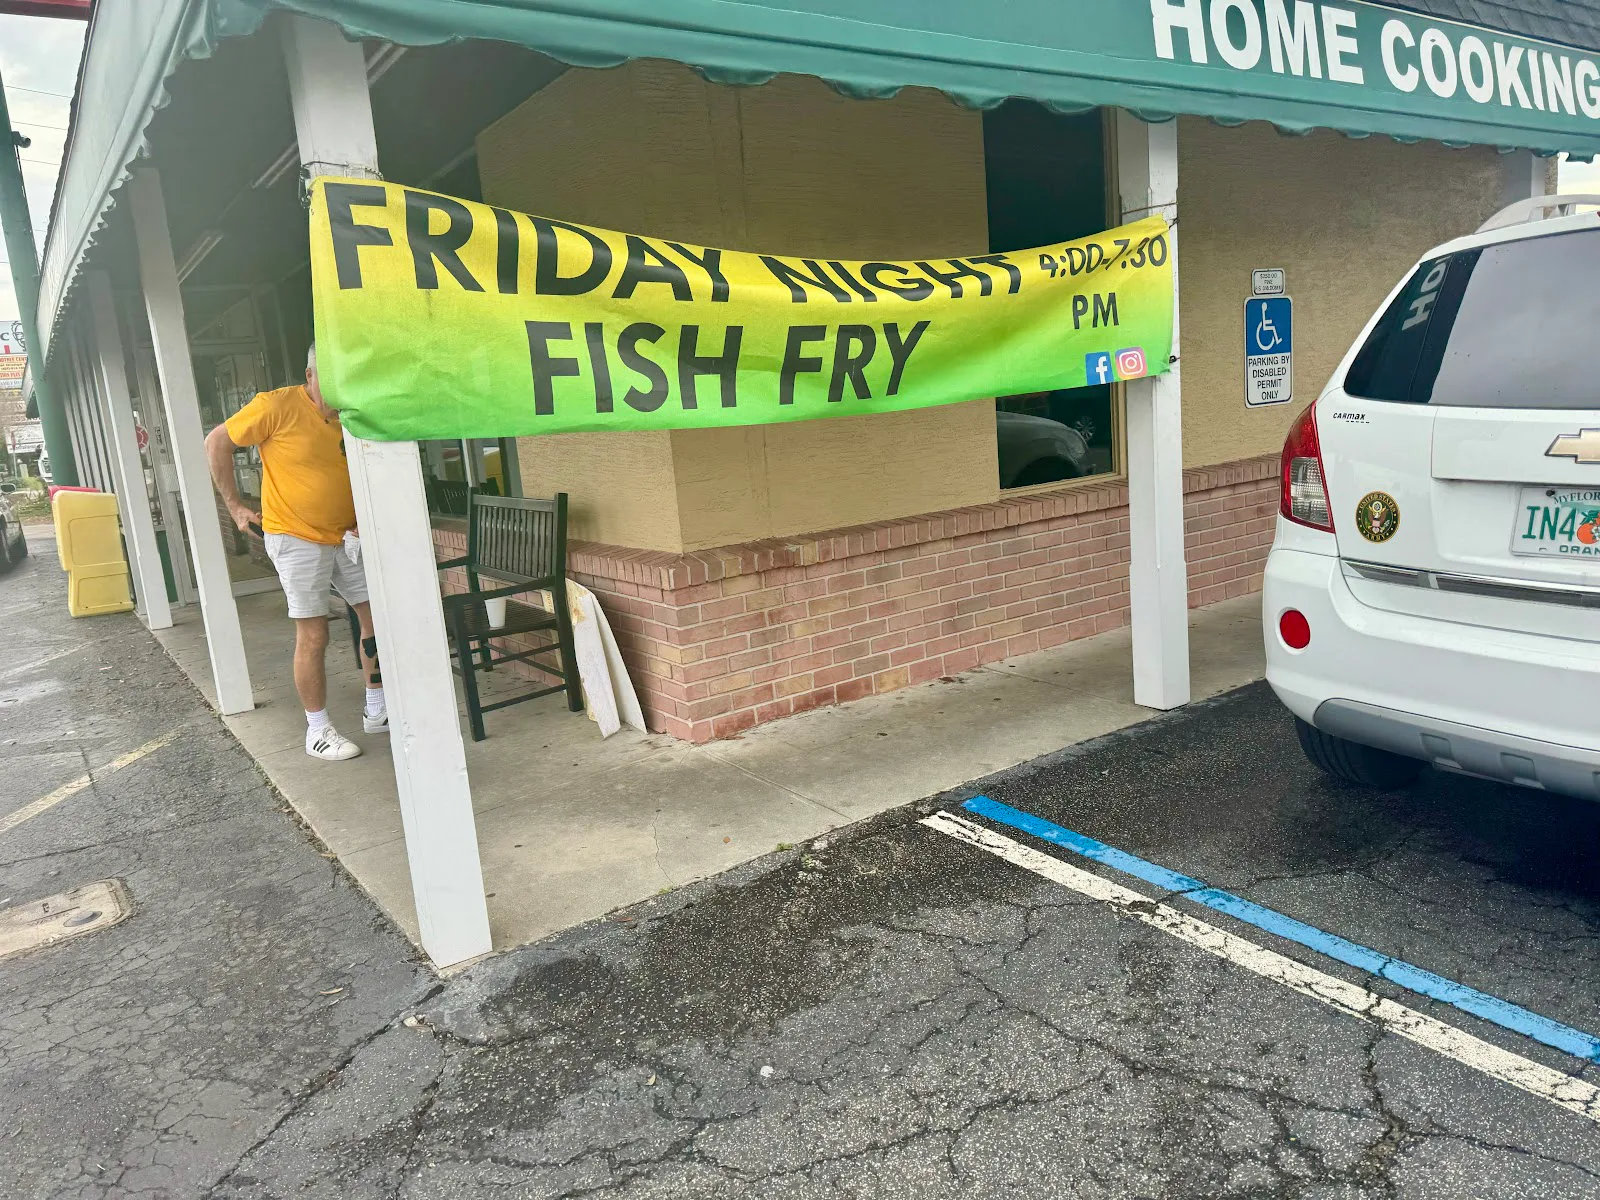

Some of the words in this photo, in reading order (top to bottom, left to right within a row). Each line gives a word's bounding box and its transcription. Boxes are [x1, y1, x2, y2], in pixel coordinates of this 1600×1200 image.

[1152, 0, 1364, 85] HOME
[1381, 19, 1600, 119] COOKING
[323, 182, 729, 303] FRIDAY
[758, 254, 1021, 303] NIGHT
[1072, 293, 1120, 330] PM
[525, 320, 744, 416] FISH
[779, 321, 931, 406] FRY
[1248, 356, 1279, 368] PARKING
[1281, 355, 1290, 364] BY
[1252, 367, 1287, 379] DISABLED
[1257, 379, 1282, 390] PERMIT
[1261, 390, 1279, 401] ONLY
[1522, 505, 1577, 542] IN4
